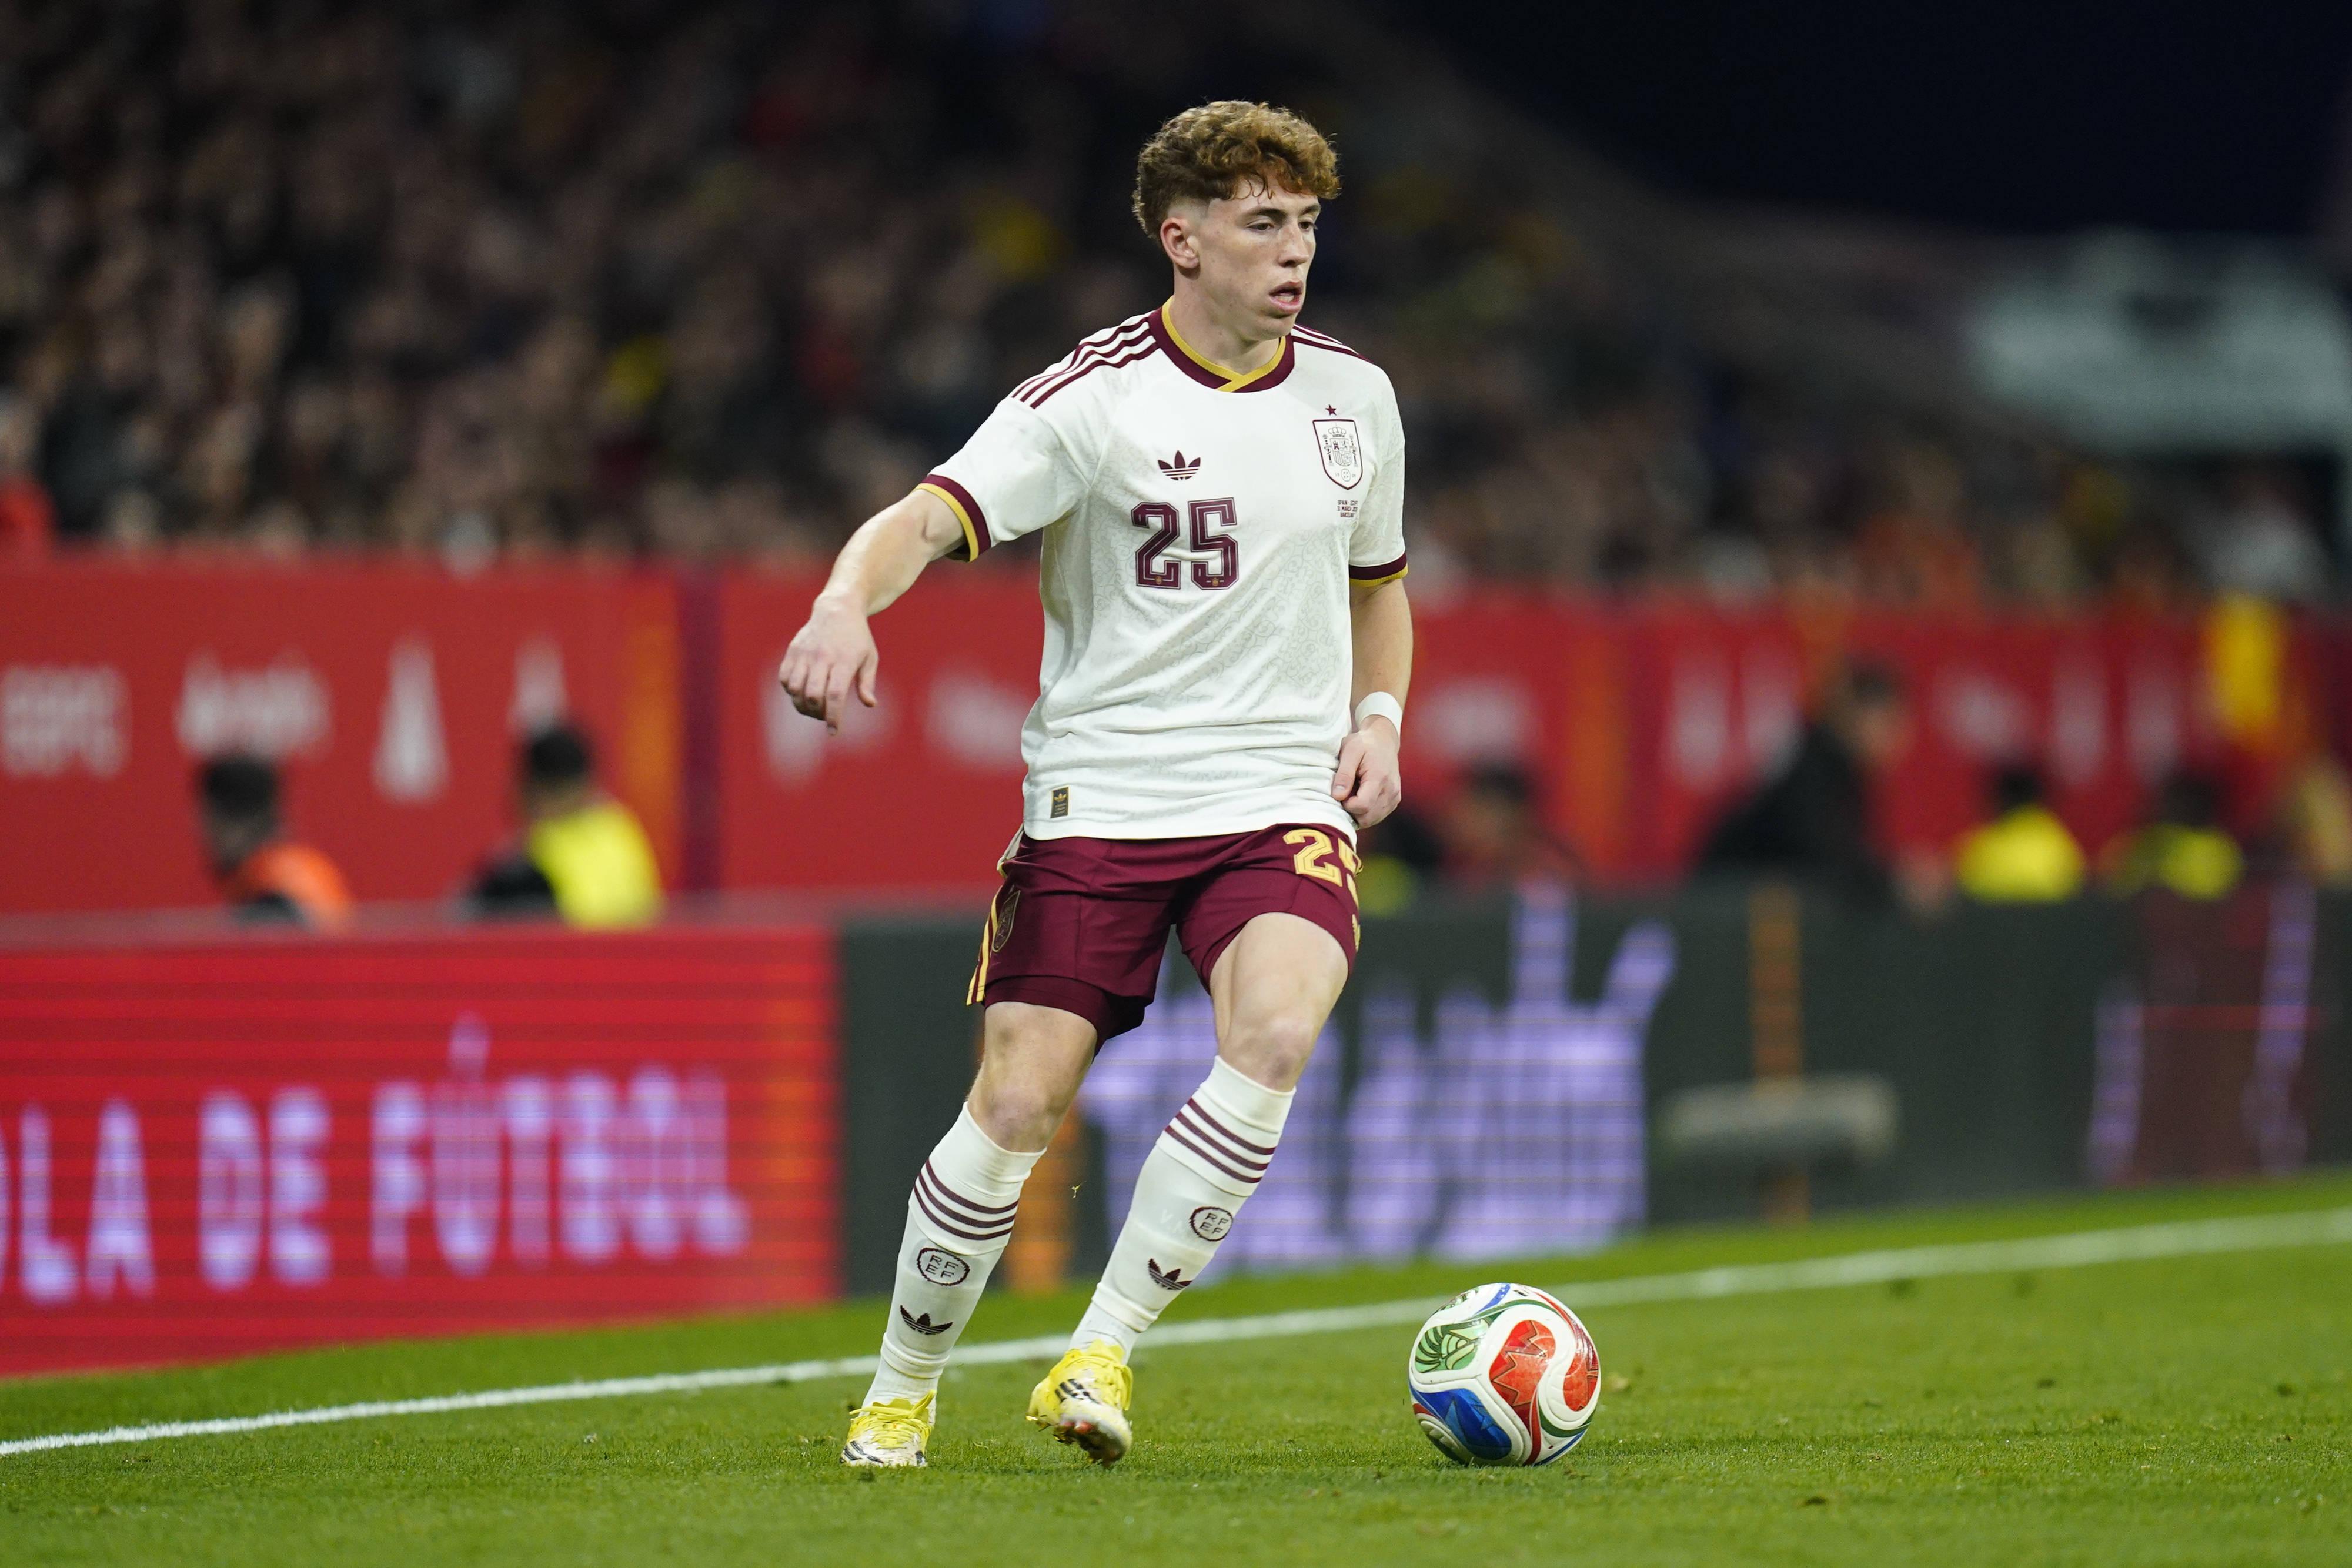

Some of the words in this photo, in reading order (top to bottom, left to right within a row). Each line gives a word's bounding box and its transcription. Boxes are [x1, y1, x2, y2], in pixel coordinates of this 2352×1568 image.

[1131, 497, 1239, 590] 25
[0, 1096, 155, 1305] LA
[198, 1086, 332, 1291] DE
[369, 1010, 750, 1282] FÚTBOL
